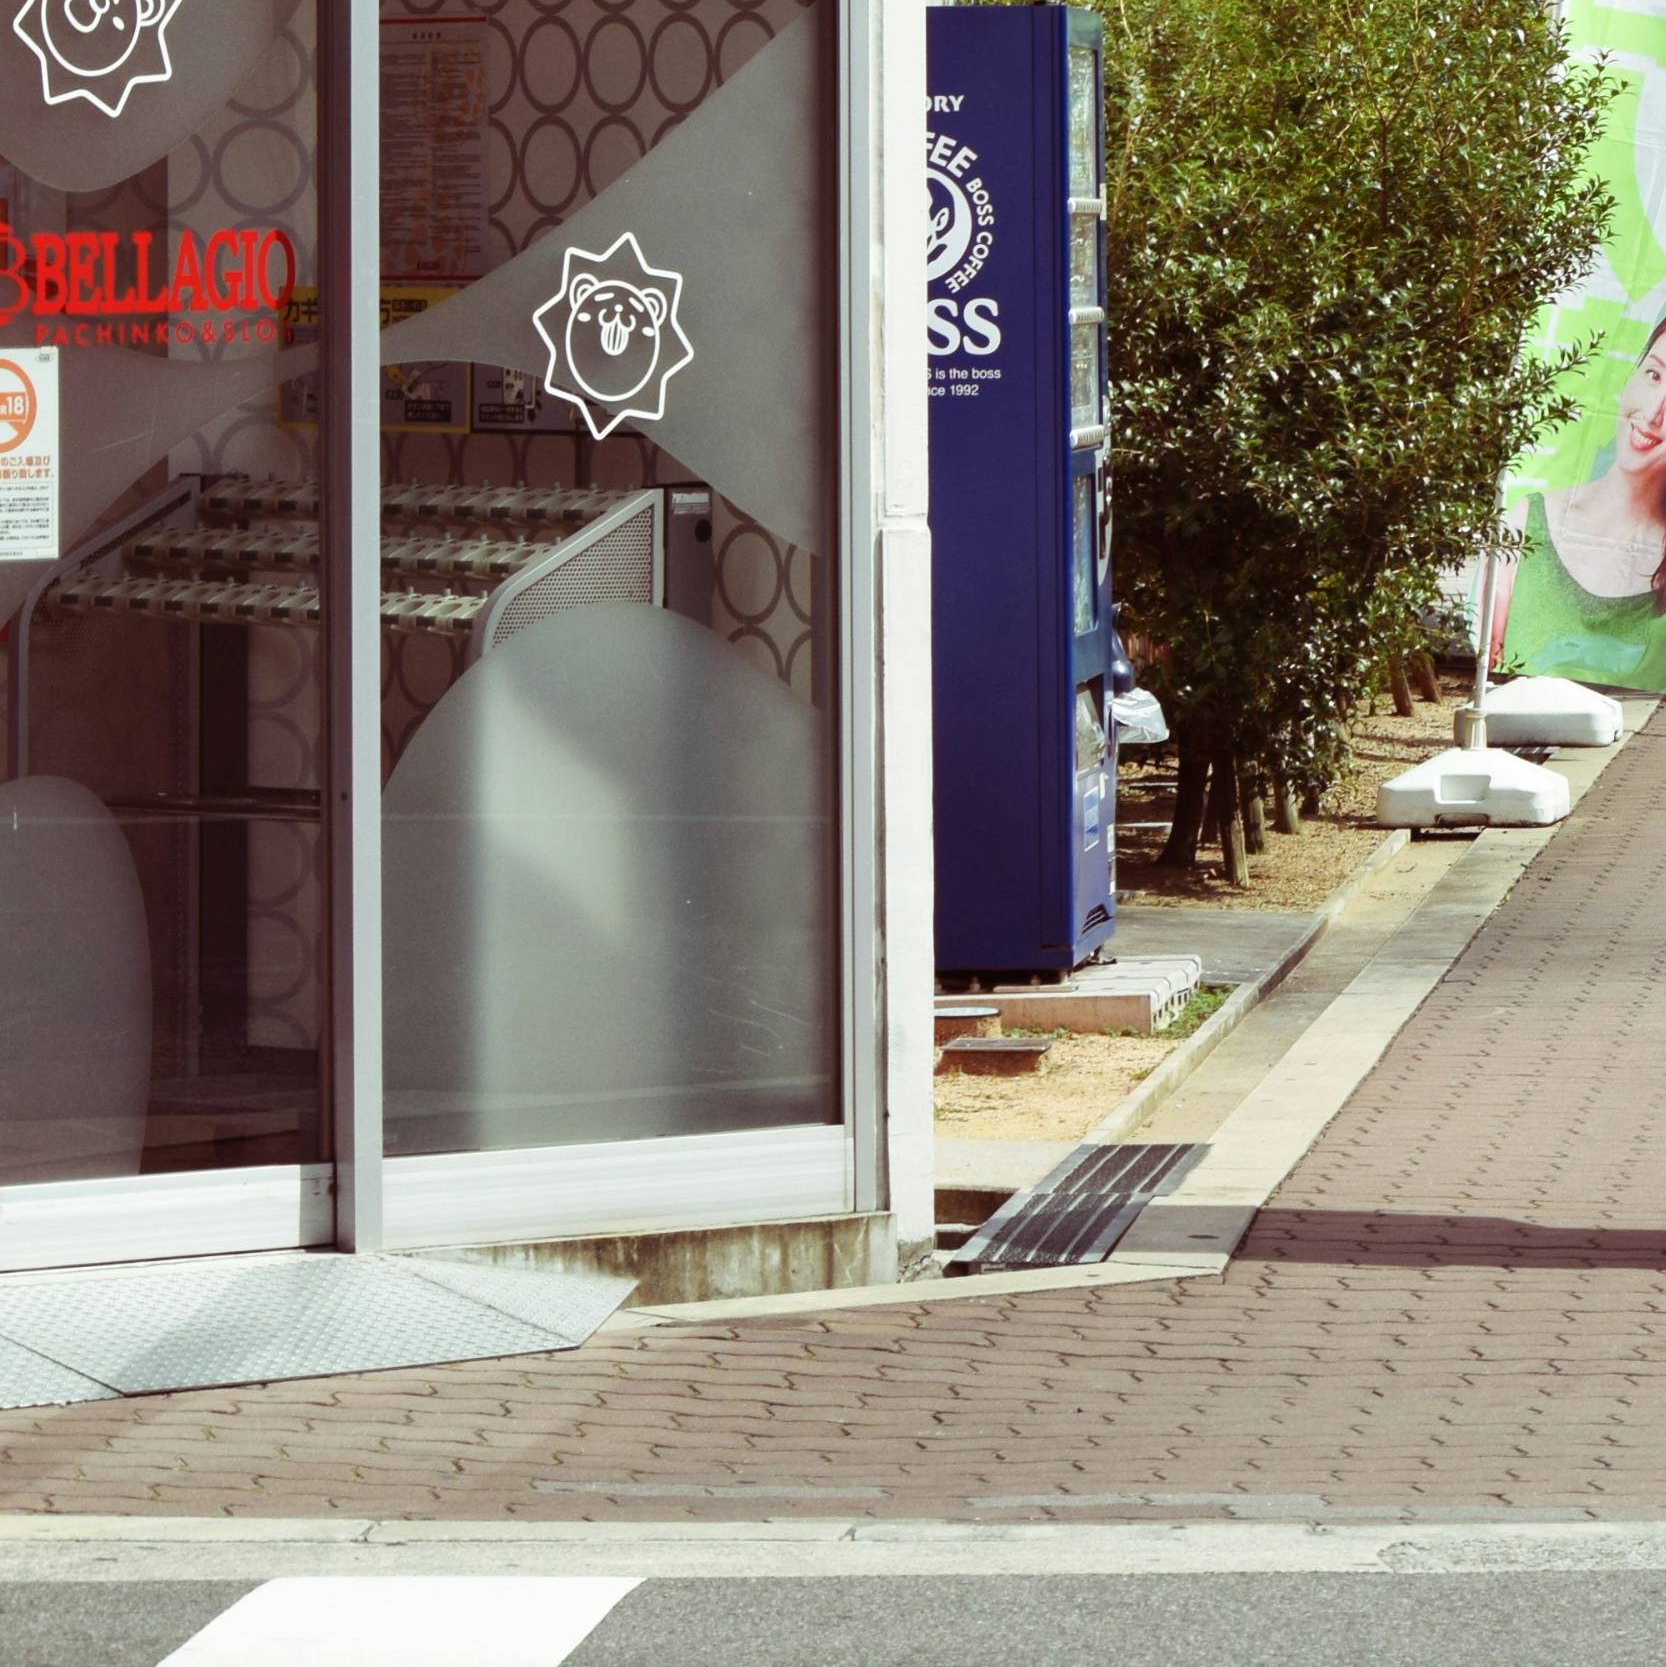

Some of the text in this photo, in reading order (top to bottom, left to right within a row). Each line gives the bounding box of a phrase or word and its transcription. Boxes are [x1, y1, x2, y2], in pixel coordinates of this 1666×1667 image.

[944, 177, 995, 294] BOSS COFFEE
[31, 228, 296, 315] BELLAGIO
[935, 367, 946, 379] is
[949, 367, 969, 379] the
[971, 367, 1001, 379] boss
[950, 384, 980, 396] 1992
